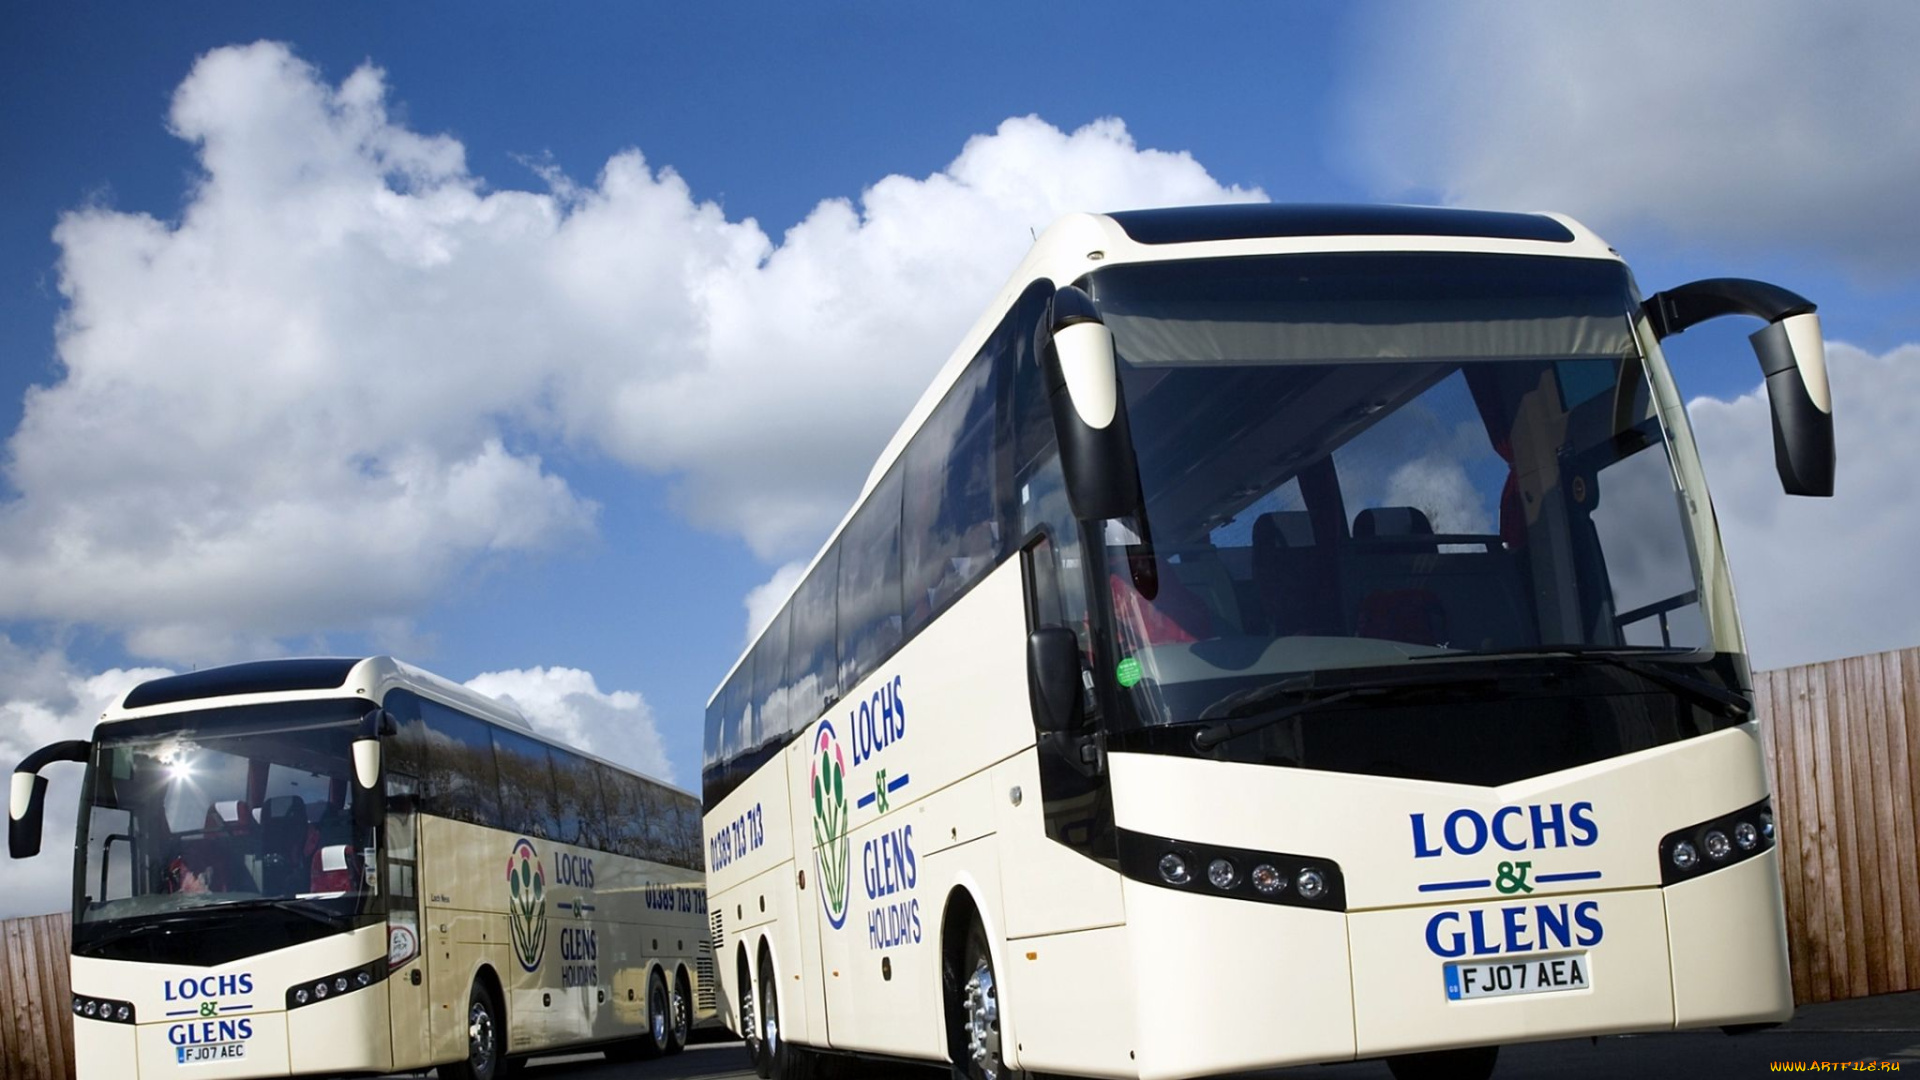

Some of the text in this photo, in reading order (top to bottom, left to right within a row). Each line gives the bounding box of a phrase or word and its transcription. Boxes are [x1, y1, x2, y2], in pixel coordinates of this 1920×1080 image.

[850, 675, 905, 767] LOCHS
[876, 768, 889, 814] &
[710, 802, 764, 873] 01389 713 713
[1409, 801, 1599, 859] LOCHS
[554, 851, 595, 889] LOCHS
[863, 824, 916, 900] GLENS
[1495, 861, 1534, 894] &
[645, 881, 675, 911] 01389
[676, 886, 691, 913] 713
[868, 898, 921, 950] HOLIDAYS
[1425, 901, 1604, 958] GLENS
[560, 928, 597, 961] GLENS
[164, 973, 253, 1001] LOCHS
[562, 965, 597, 988] HOLIDAYS
[1462, 959, 1584, 994] FJ07 AEA
[200, 1002, 218, 1017] &
[168, 1018, 253, 1046] GLENS
[186, 1044, 244, 1060] FJ07 AEC
